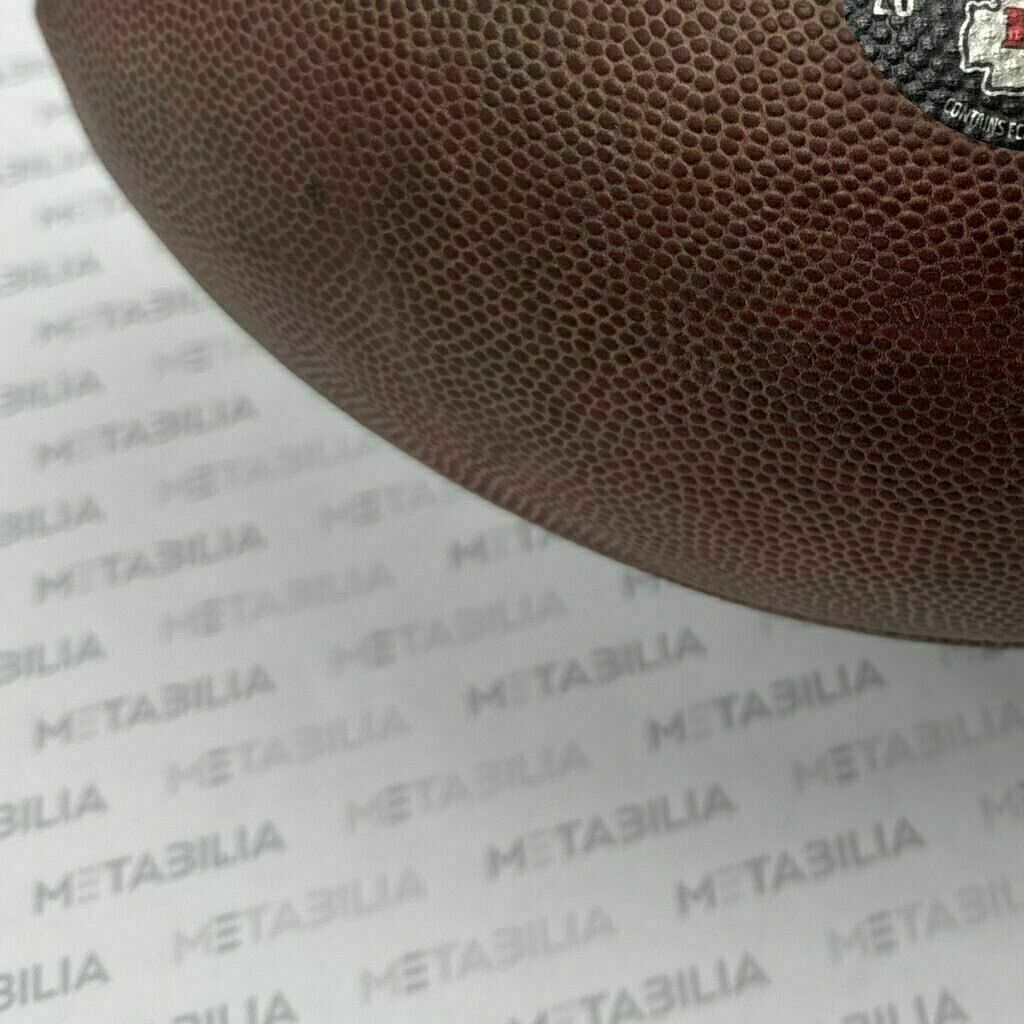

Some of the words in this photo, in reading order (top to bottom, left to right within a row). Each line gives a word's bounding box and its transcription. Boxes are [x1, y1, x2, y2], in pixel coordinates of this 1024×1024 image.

[944, 98, 1007, 136] CONTAINS
[33, 663, 277, 752] METABILIA
[465, 627, 708, 718] METABILIA
[645, 657, 887, 753] METABILIA
[0, 781, 109, 841] BILIA
[485, 780, 739, 880] METABILIA
[31, 819, 287, 916] METABILIA
[675, 815, 928, 918] METABILIA
[0, 949, 112, 1014] BILIA
